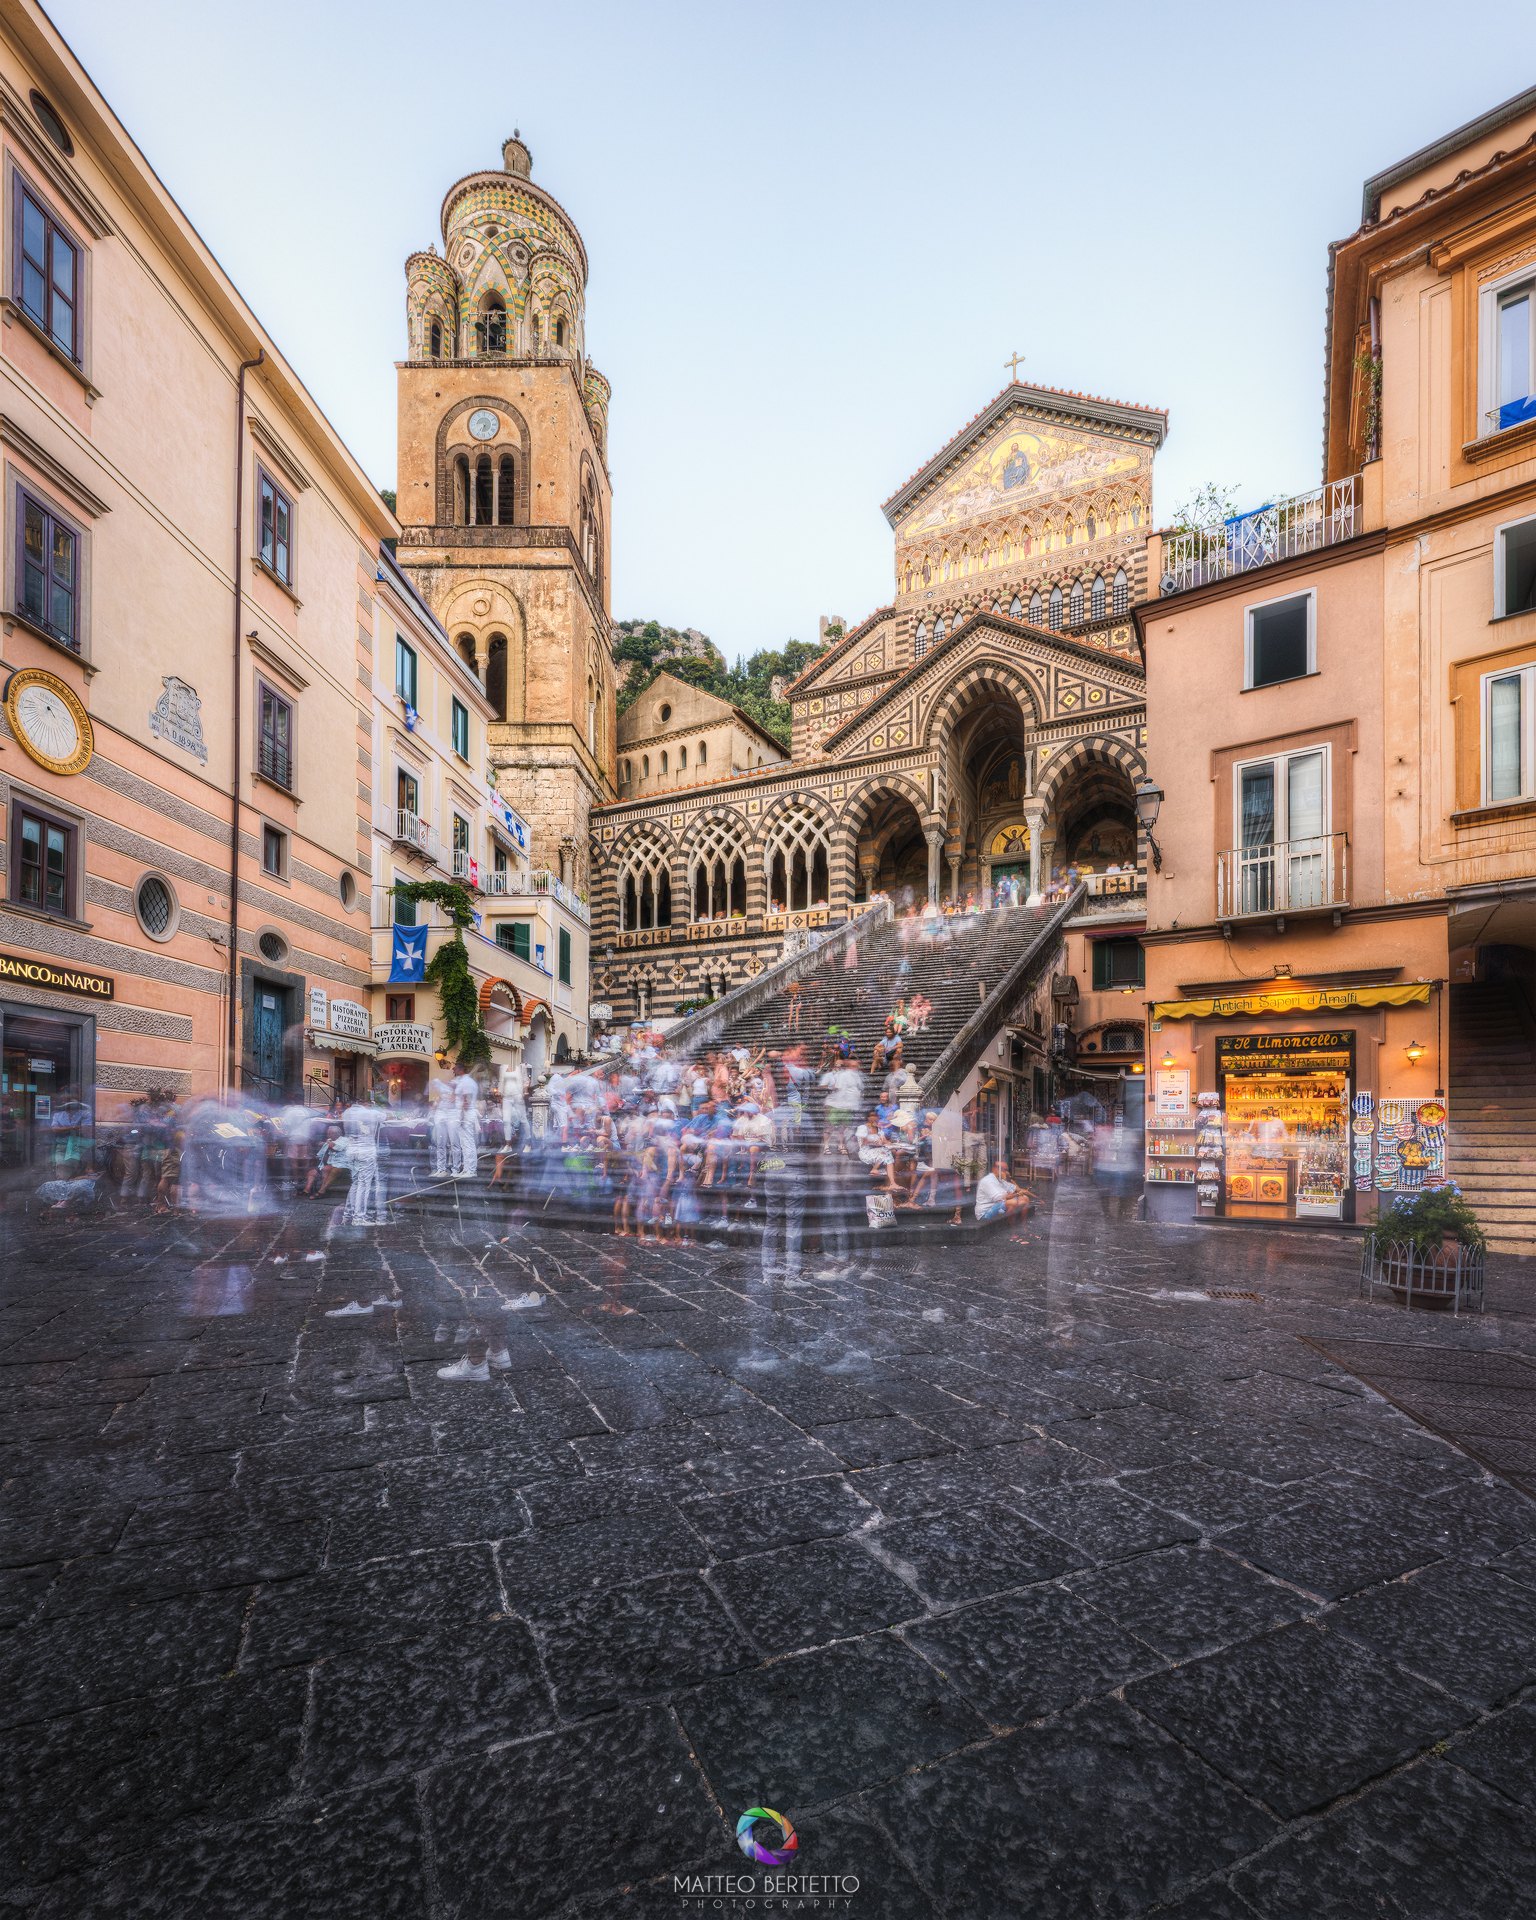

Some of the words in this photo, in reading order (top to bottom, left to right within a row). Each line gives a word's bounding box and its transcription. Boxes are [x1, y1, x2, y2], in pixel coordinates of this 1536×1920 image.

[178, 734, 196, 751] 1898
[0, 958, 51, 982] BANCO
[51, 973, 63, 985] DI
[64, 972, 111, 995] NAPOLI
[1212, 998, 1253, 1012] Antichi
[1258, 995, 1300, 1009] Sapori
[1307, 991, 1358, 1005] d'Amalfi
[332, 1004, 368, 1020] RISTORANTE
[312, 1018, 326, 1026] COFFEE
[337, 1014, 364, 1027] PIZZERIA
[334, 1022, 341, 1030] S.
[343, 1024, 366, 1036] ANDREA
[374, 1028, 431, 1039] RISTORANTE
[341, 1041, 360, 1052] ANDREA
[381, 1035, 423, 1045] PIZZERIA
[1257, 1034, 1338, 1049] Limoncello
[377, 1044, 386, 1053] S.
[389, 1043, 427, 1053] ANDREA
